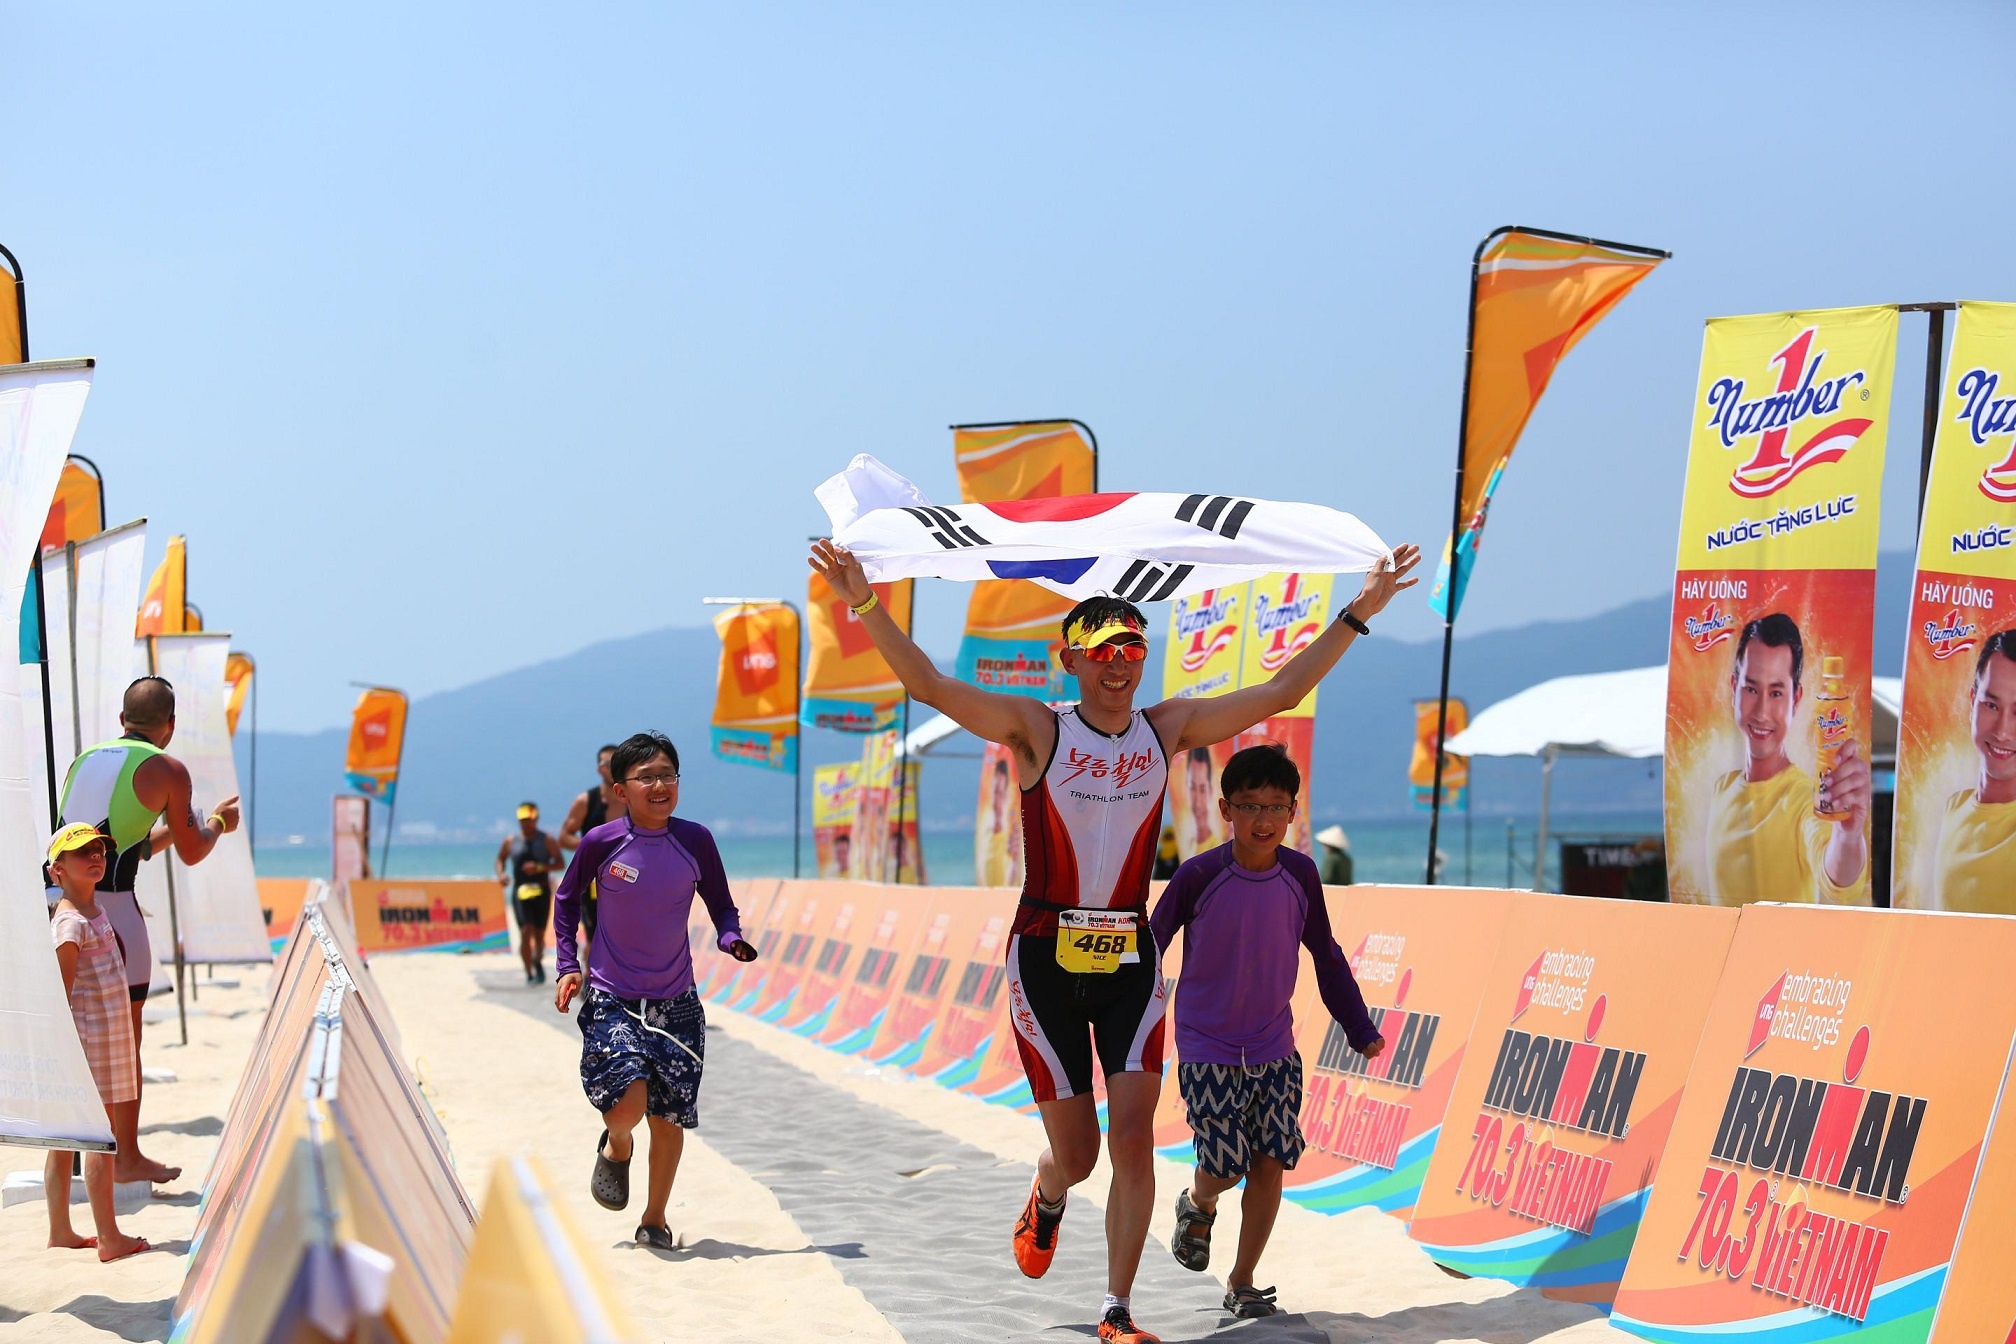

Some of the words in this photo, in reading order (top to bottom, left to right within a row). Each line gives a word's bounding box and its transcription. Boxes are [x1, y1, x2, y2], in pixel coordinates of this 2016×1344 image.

[1706, 350, 1865, 447] Number
[1740, 328, 1814, 472] 1
[1707, 521, 1763, 550] NƯỚC
[1766, 508, 1812, 535] TĂNG
[1816, 496, 1855, 521] LỰC
[1952, 525, 2011, 552] NƯỚC
[1709, 576, 1748, 599] UỐNG
[1951, 581, 1993, 609] UỐNG
[1254, 583, 1319, 638] Number
[1685, 611, 1732, 638] Number
[1697, 602, 1716, 645] 1
[1923, 615, 1975, 645] Number
[1934, 608, 1959, 653] 1
[976, 657, 1047, 672] IRONMAN
[1069, 790, 1124, 803] TRIATHLON
[1127, 790, 1150, 800] TEAM
[379, 905, 479, 923] IRONMAN
[1087, 916, 1117, 924] IRONMAN
[1073, 933, 1127, 954] 468
[1541, 947, 1595, 986] embracing
[1531, 976, 1588, 1015] challenges
[1781, 969, 1852, 1015] embracing
[1770, 1004, 1843, 1050] challenges
[1482, 1025, 1648, 1138] IRONMAN
[1332, 1092, 1412, 1171] VIETNAM
[1709, 1063, 1929, 1204] IRONMAN
[1456, 1111, 1526, 1206] 70.3
[1509, 1138, 1614, 1236] VIETNAM
[1677, 1165, 1769, 1279] 70.3
[1751, 1200, 1891, 1323] VIETNAM
